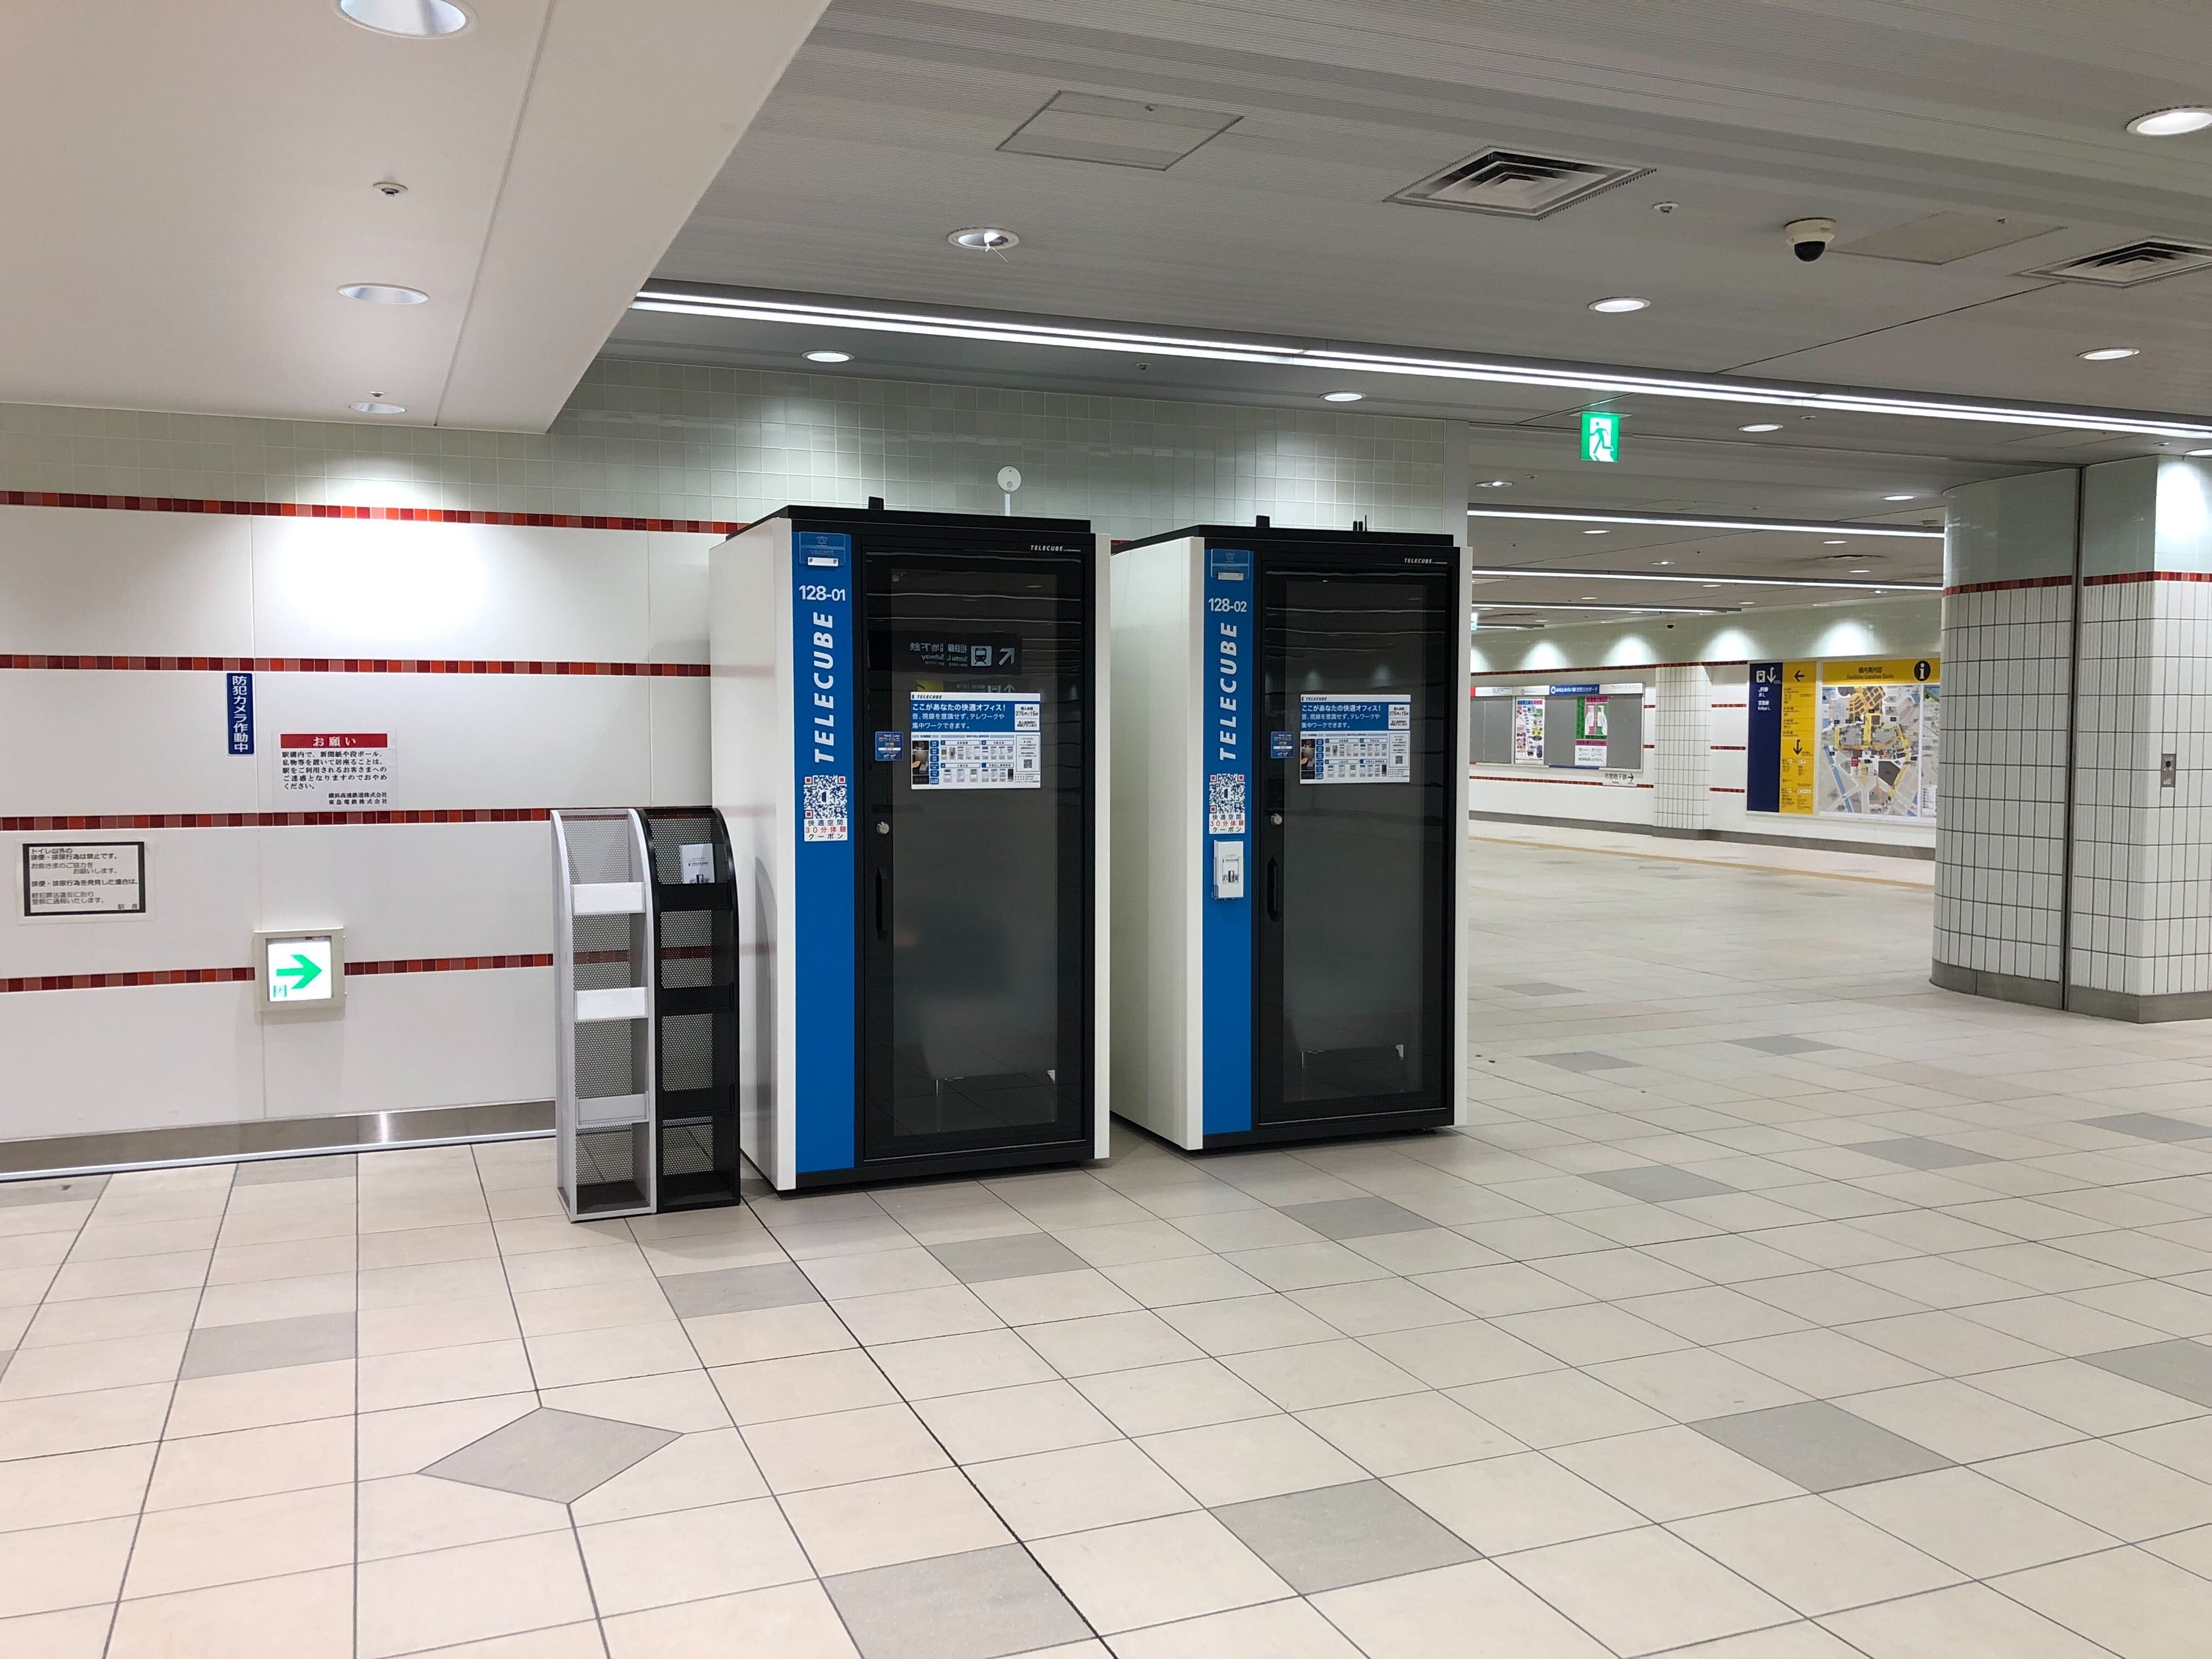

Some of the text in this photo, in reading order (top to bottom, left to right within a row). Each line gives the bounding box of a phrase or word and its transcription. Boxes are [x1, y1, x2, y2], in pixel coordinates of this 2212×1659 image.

[799, 585, 846, 601] 128-01
[1208, 598, 1247, 612] 128-02
[813, 612, 834, 763] TELECUBE
[1219, 622, 1237, 761] TELECUBE
[232, 675, 248, 753] 防犯カメラ作動中
[912, 703, 1006, 712] ここがあなたの快適オフィス!
[313, 736, 356, 747] お願い
